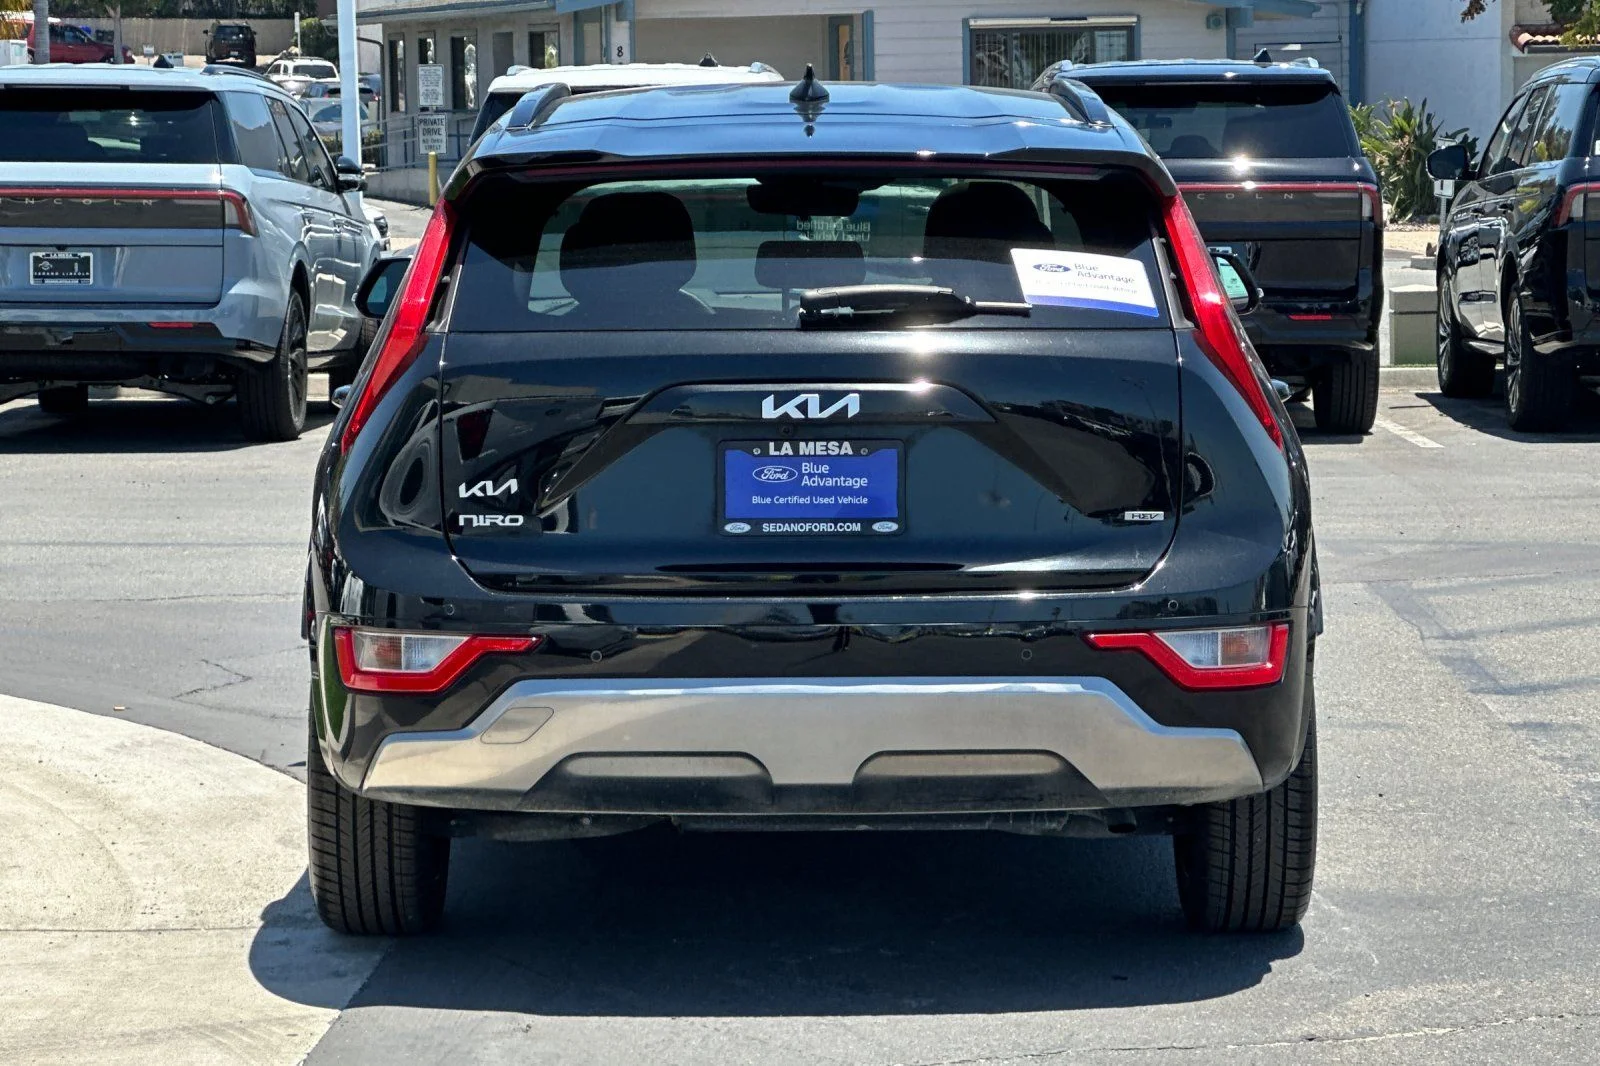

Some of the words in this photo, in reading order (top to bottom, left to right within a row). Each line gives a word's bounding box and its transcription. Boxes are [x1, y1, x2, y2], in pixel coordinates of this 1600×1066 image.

[616, 46, 624, 57] 8
[418, 118, 444, 126] PRIVATE
[422, 127, 442, 136] DRIVE
[1074, 263, 1099, 272] Blue
[1077, 271, 1135, 284] Advantage
[761, 393, 860, 419] KIA
[769, 441, 794, 455] LA
[800, 441, 853, 455] MESA
[801, 462, 830, 474] Blue
[801, 475, 868, 489] Advantage
[458, 478, 518, 498] KIA
[752, 495, 772, 504] Blue
[774, 495, 810, 504] Certified
[812, 495, 835, 504] Used
[837, 495, 868, 504] Vehicle
[762, 522, 861, 532] SEDANOFORD.COM
